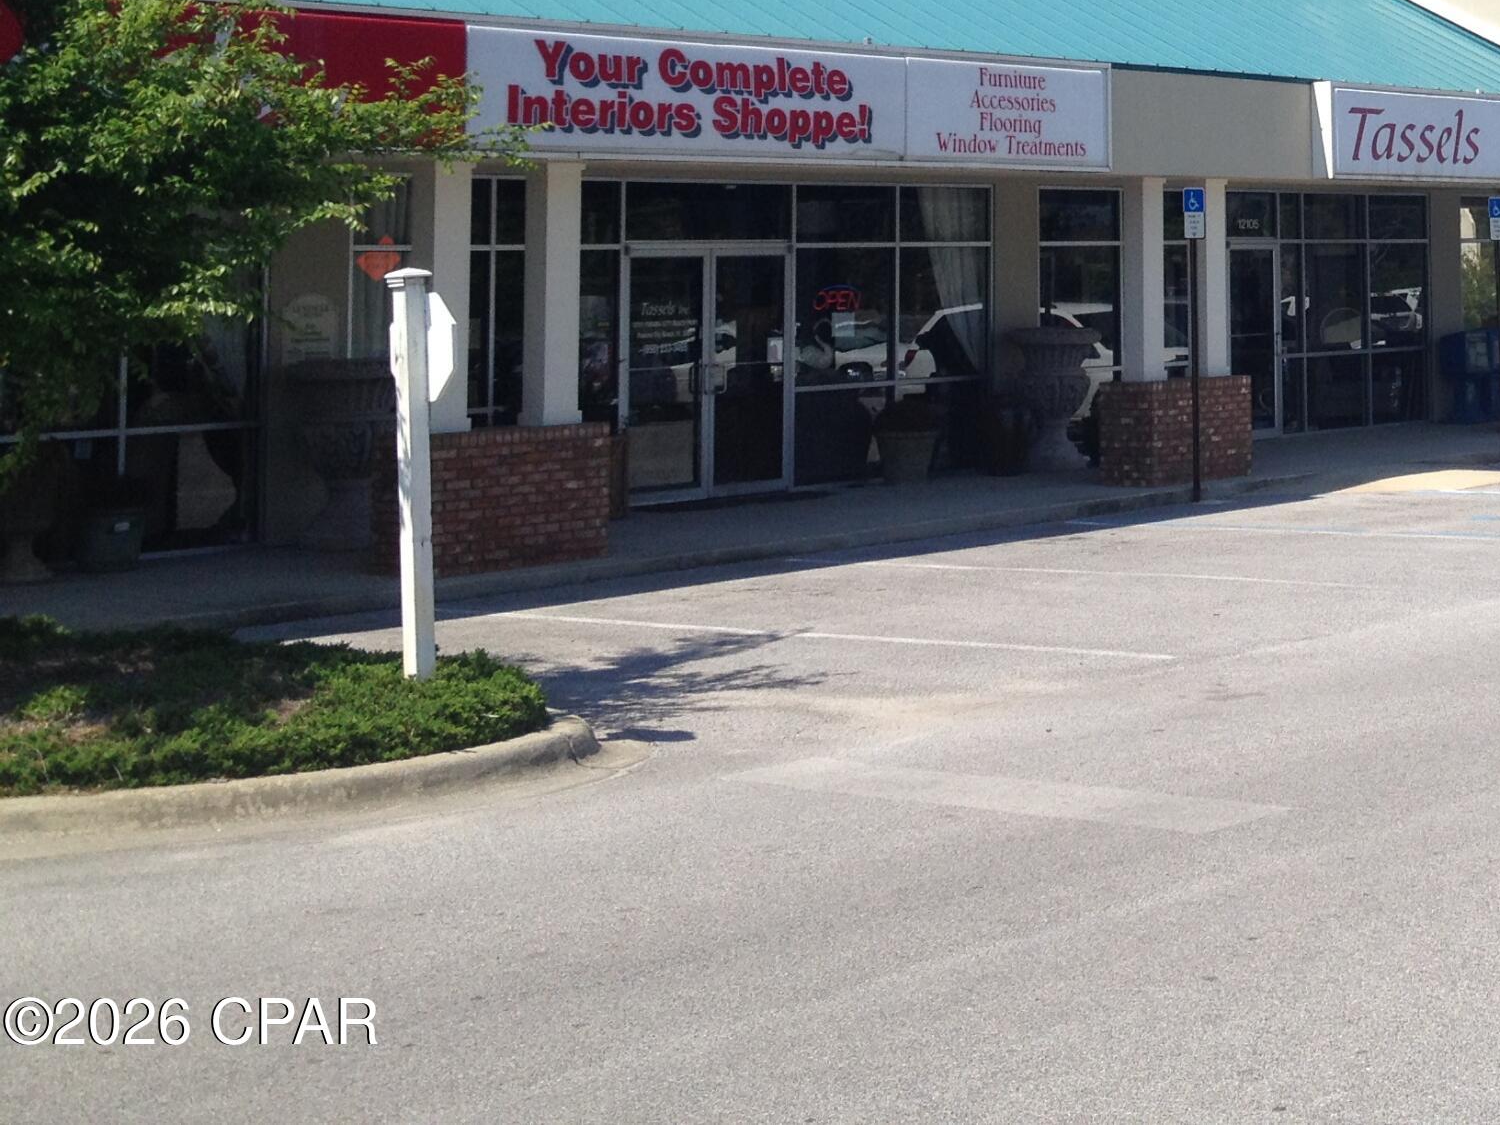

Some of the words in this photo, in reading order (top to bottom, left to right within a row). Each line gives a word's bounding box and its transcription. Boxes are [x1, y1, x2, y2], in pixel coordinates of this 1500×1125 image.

[534, 40, 648, 90] Your
[658, 48, 853, 101] Complete
[978, 68, 1047, 91] Furniture
[970, 90, 1057, 113] Accessories
[507, 84, 701, 137] Interiors
[713, 95, 873, 147] Shoppe!
[979, 112, 1043, 137] Flooring
[936, 132, 1000, 156] Window
[1006, 135, 1087, 158] Treatments
[1348, 107, 1481, 165] Tassels
[813, 290, 862, 312] OPEN
